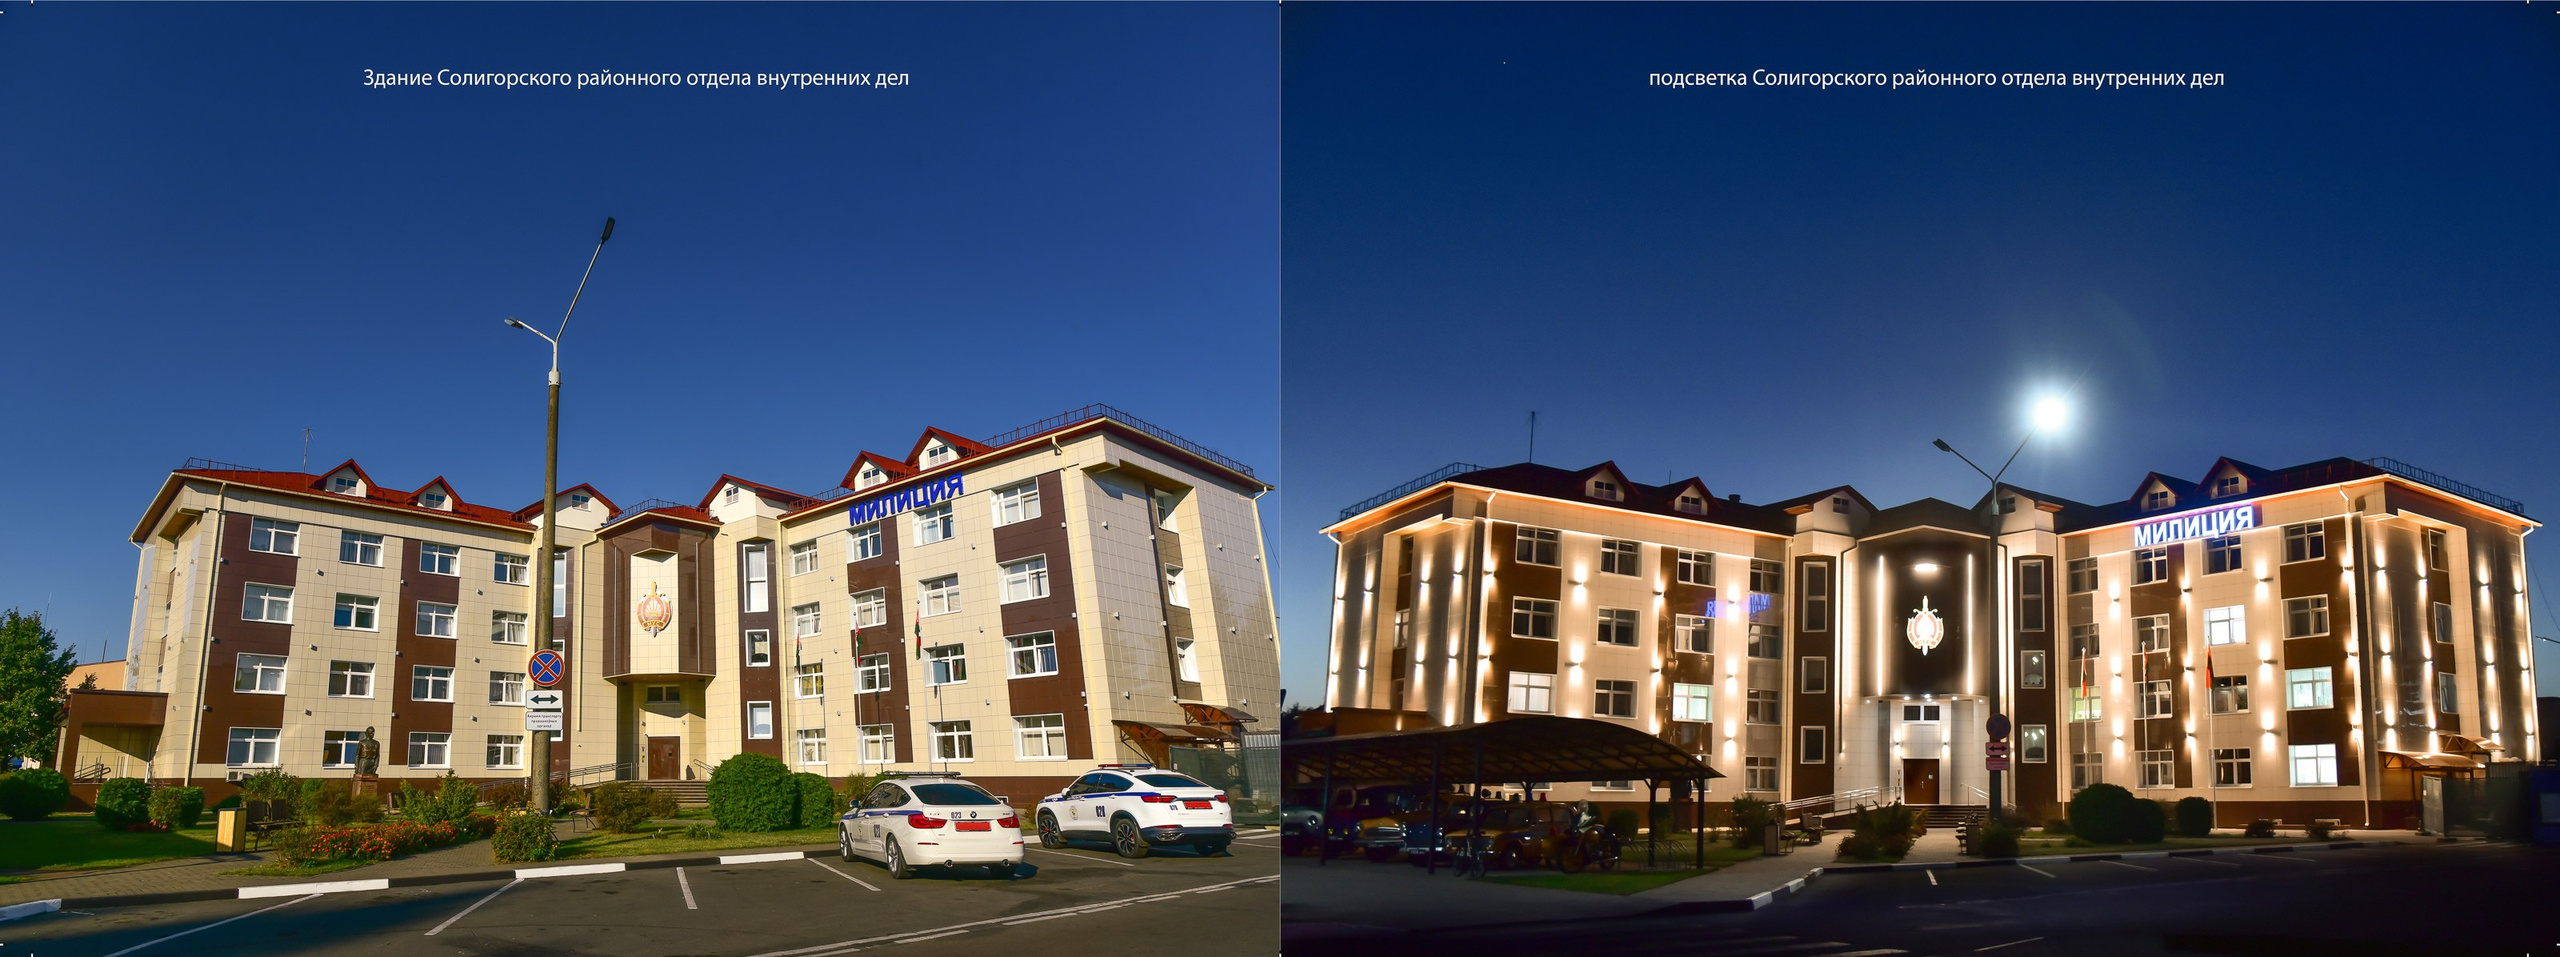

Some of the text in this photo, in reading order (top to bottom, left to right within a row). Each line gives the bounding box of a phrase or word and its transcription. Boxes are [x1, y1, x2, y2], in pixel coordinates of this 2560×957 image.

[849, 472, 964, 526] МИЛИЦИЯ
[2134, 505, 2254, 547] МИЛИЦИЯ
[951, 811, 962, 819] 023
